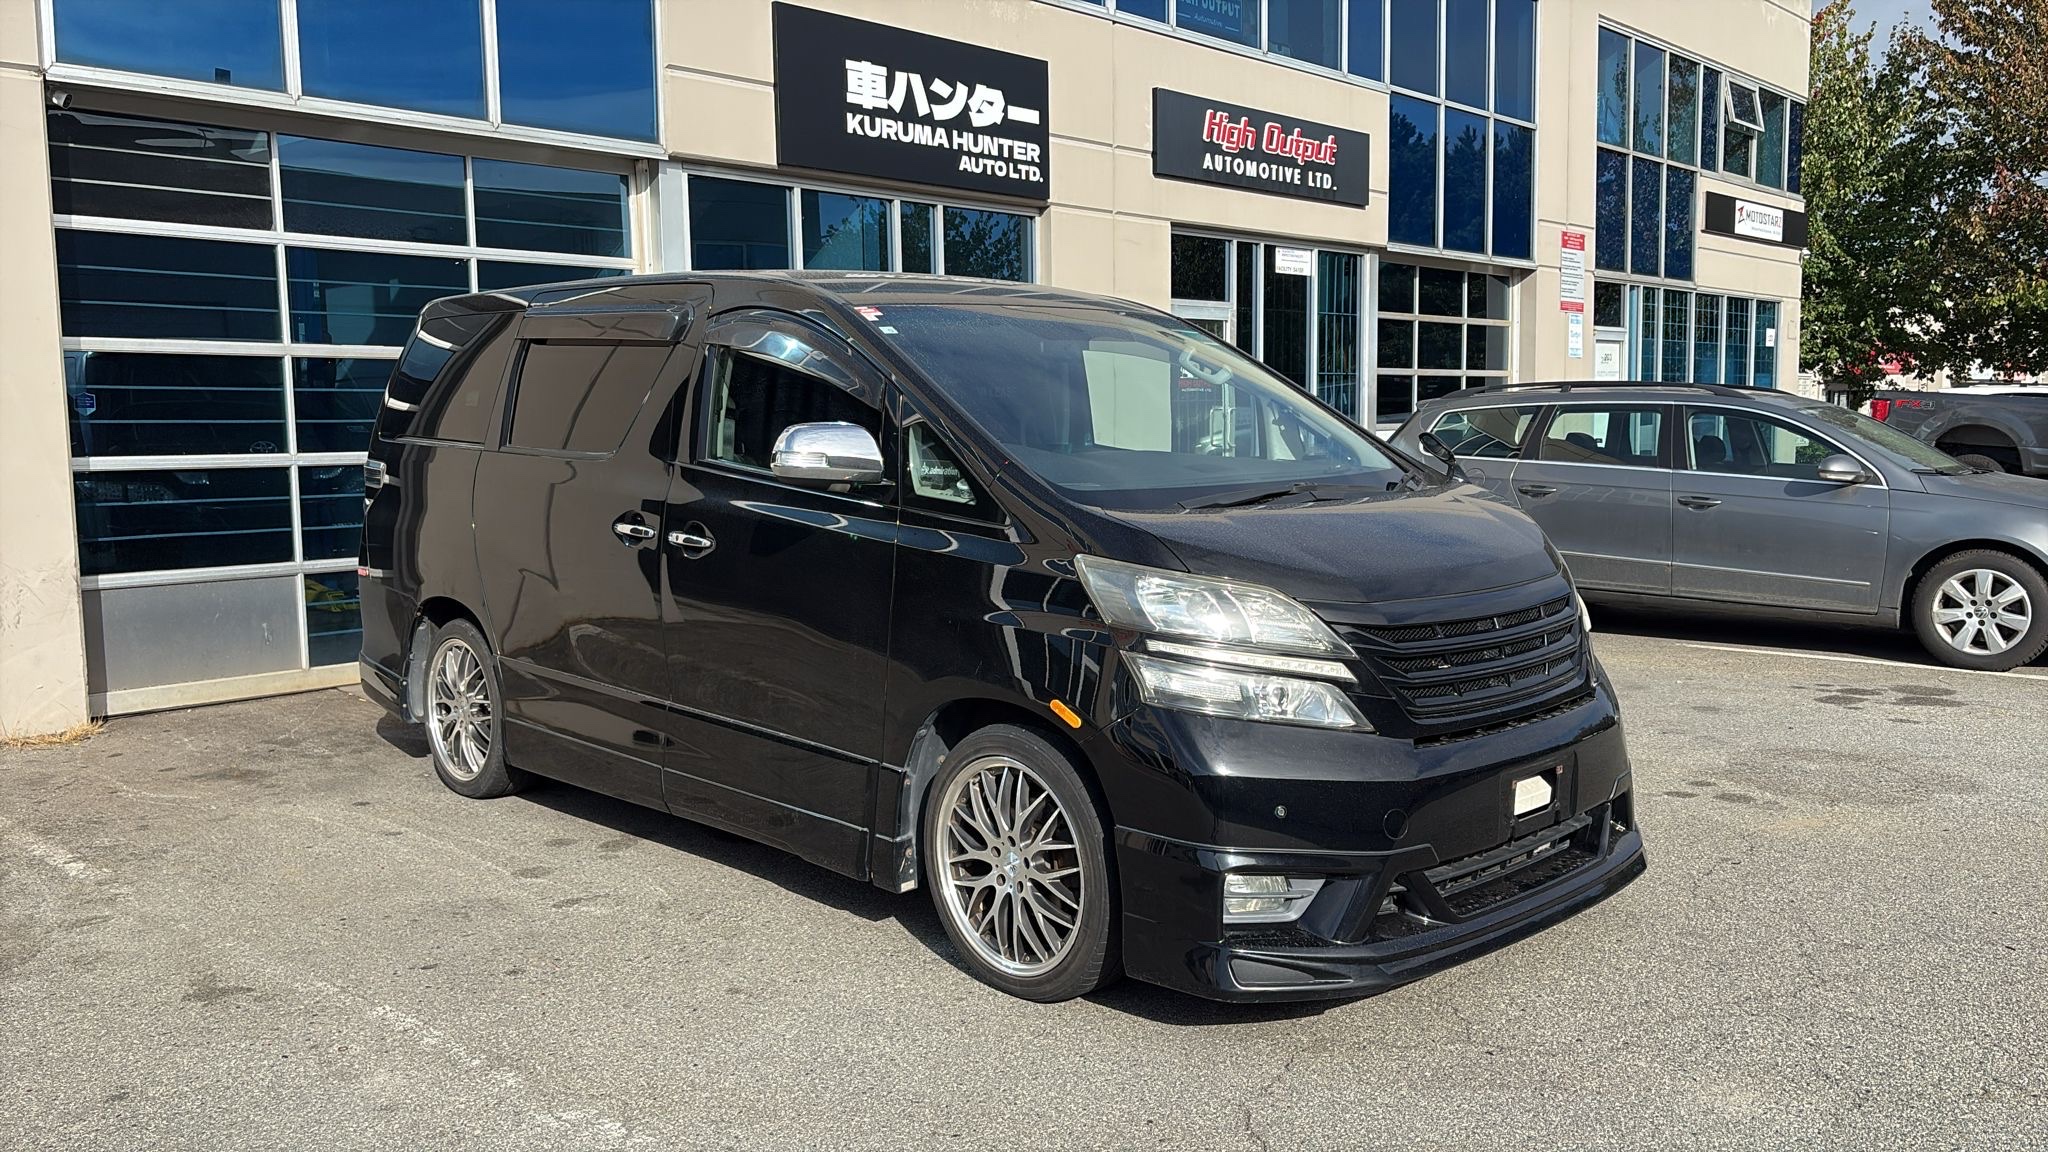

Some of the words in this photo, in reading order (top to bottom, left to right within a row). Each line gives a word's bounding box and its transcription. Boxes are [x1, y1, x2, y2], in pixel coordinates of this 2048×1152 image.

[845, 59, 1040, 128] 車ハンター
[846, 112, 949, 149] KURUMA
[952, 129, 1041, 163] HUNTER
[1203, 108, 1256, 153] High
[1262, 122, 1337, 165] Output
[958, 155, 1007, 177] AUTO
[1008, 162, 1044, 183] LTD.
[1202, 152, 1301, 185] AUTOMOTIVE
[1308, 171, 1338, 191] LTD.
[1745, 209, 1782, 228] MOTOSTARZ
